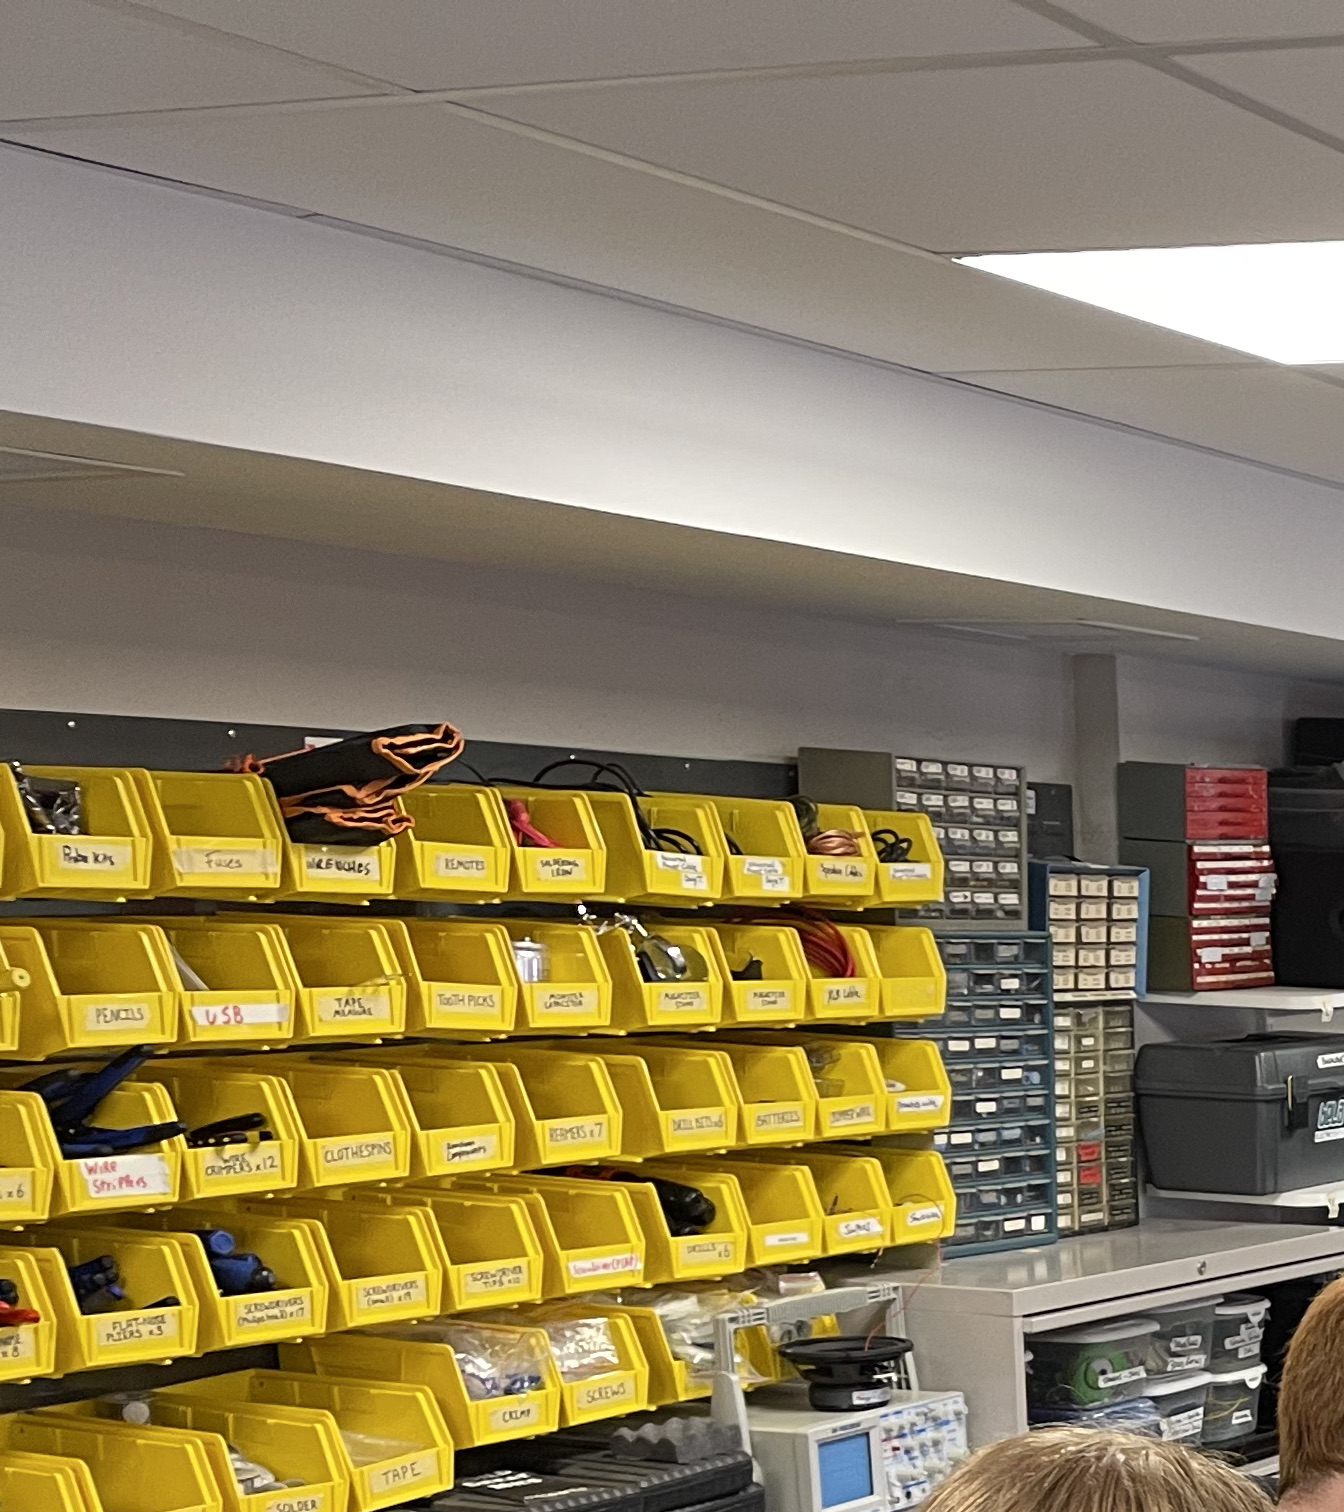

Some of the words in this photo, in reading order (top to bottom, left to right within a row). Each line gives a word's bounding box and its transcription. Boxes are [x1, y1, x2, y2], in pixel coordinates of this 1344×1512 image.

[205, 1006, 244, 1025] USB
[324, 1141, 392, 1164] CLOTHESPINS
[585, 1382, 626, 1404] SCREWS
[381, 1463, 422, 1483] TAPE
